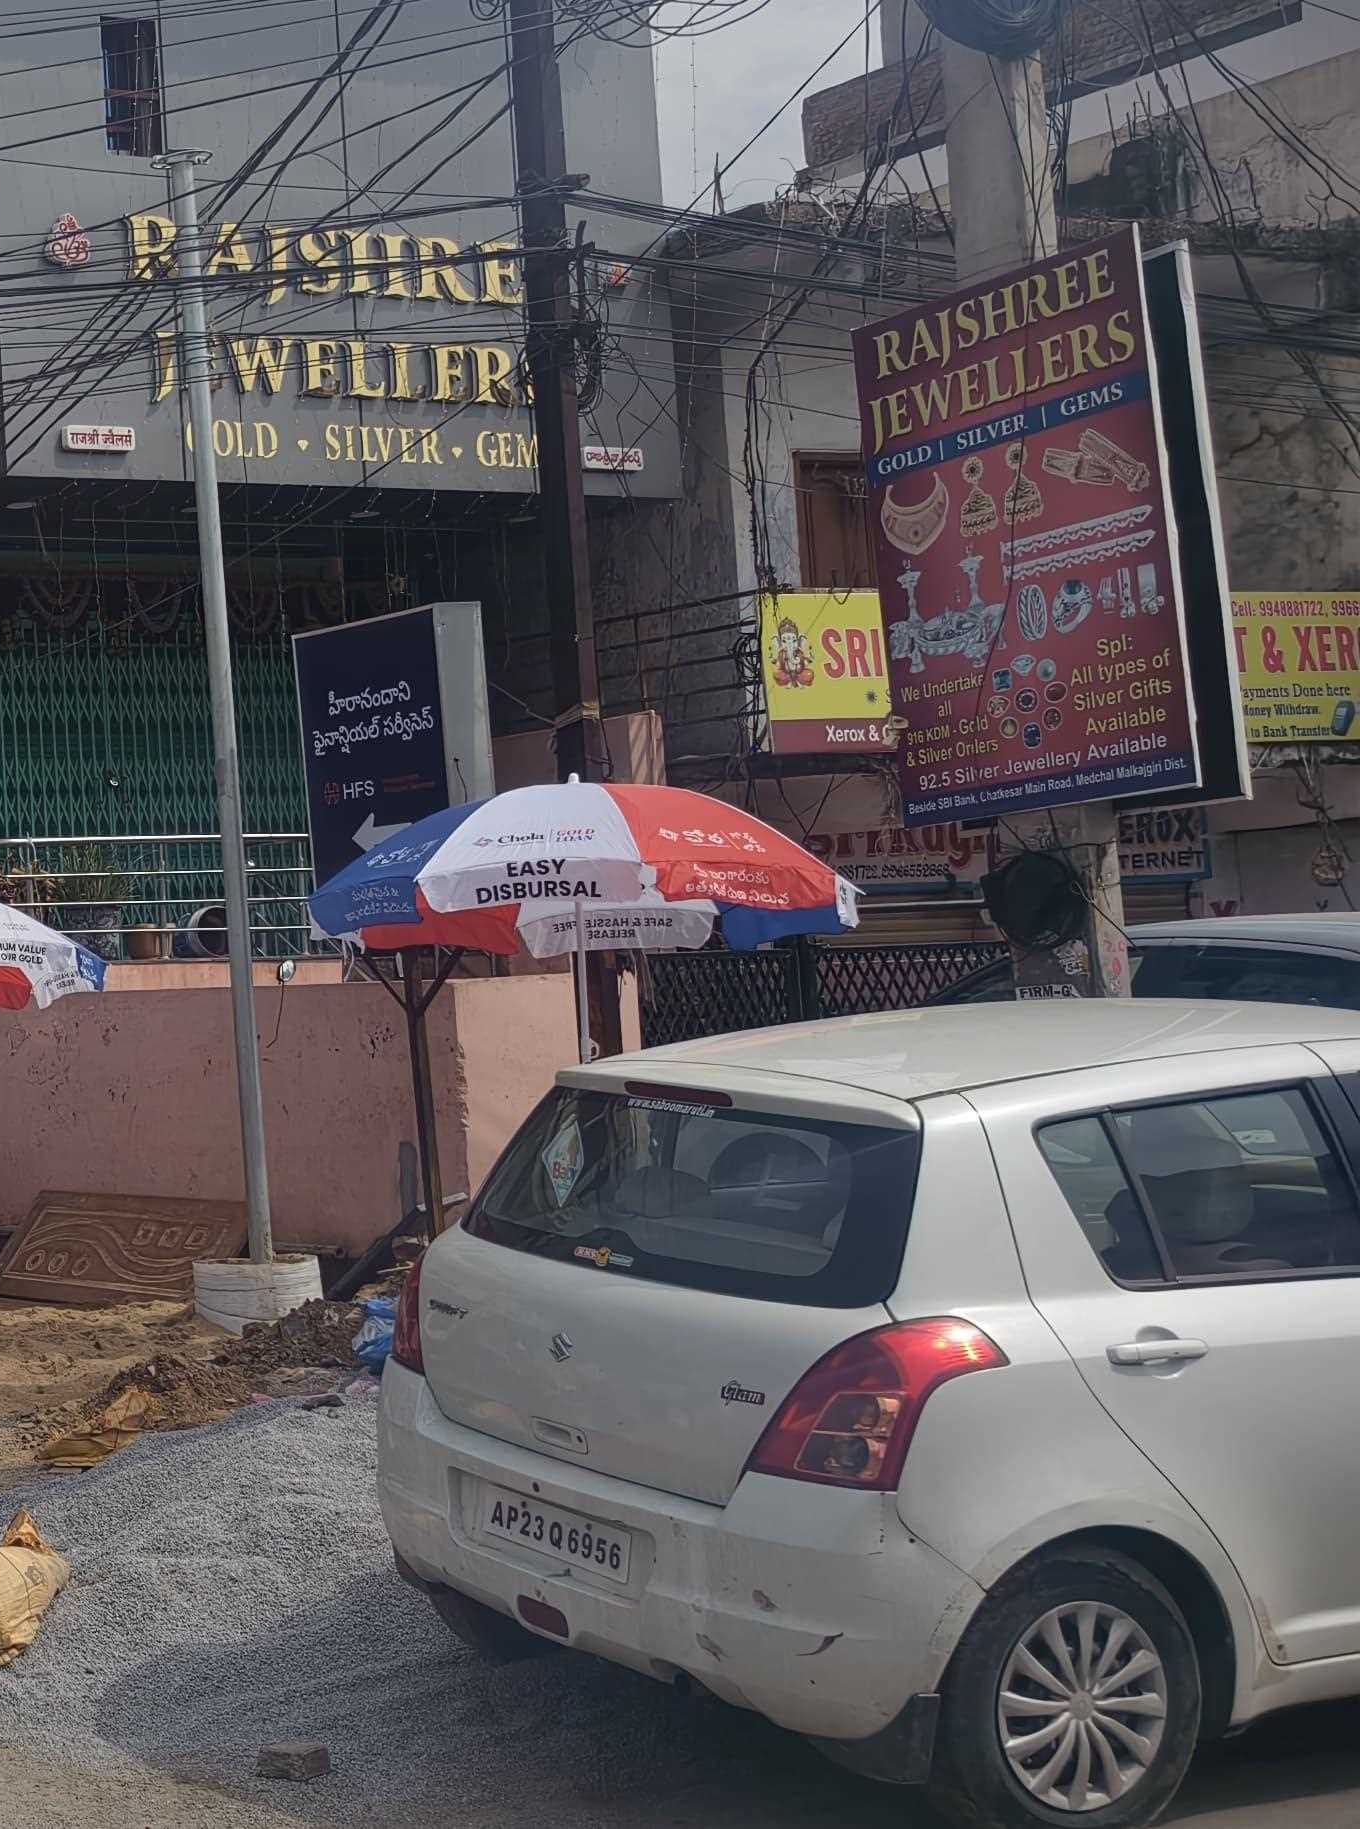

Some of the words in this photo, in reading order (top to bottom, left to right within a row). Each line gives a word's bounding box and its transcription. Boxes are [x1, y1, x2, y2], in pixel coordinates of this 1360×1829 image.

[127, 215, 524, 305] RAJSHRE
[873, 249, 1114, 379] RAJSHREE
[153, 330, 535, 404] JWELLER
[868, 310, 1135, 454] JEWELLERS
[878, 445, 930, 474] GOLD
[956, 415, 1028, 449] SILVER
[1060, 382, 1123, 417] GEMS
[325, 424, 443, 465] SILVER
[476, 430, 538, 468] GEM
[821, 628, 883, 678] SRI
[1096, 634, 1133, 658] Spl:
[1261, 625, 1285, 673] &
[1292, 625, 1360, 672] XER
[1071, 666, 1093, 687] All
[1098, 658, 1146, 684] types
[1152, 648, 1170, 669] of
[901, 687, 920, 703] We
[924, 672, 984, 698] Undertake
[1073, 689, 1123, 711] Silver
[1130, 679, 1172, 700] Gifts
[1240, 684, 1289, 701] ayments
[1292, 683, 1323, 698] Done
[1326, 682, 1351, 697] here
[938, 700, 952, 717] all
[1086, 705, 1167, 735] Available
[826, 724, 865, 742] Xerox
[869, 724, 879, 742] &
[907, 730, 924, 746] 916
[926, 725, 950, 741] KDM
[919, 747, 953, 765] Silver
[919, 772, 951, 791] 92.5
[955, 765, 999, 784] Silver
[1004, 750, 1081, 775] Jewellery
[1087, 733, 1168, 760] Available
[1164, 757, 1188, 770] Dist.
[343, 780, 375, 799] HFS
[497, 832, 544, 844] Chola
[1119, 808, 1195, 844] EROX
[507, 859, 566, 877] EASY
[1119, 850, 1204, 870] TERNET
[476, 880, 602, 905] DISBURSAL
[18, 943, 47, 956] VALUE
[19, 954, 43, 965] GOLD
[491, 1501, 545, 1541] AP23
[549, 1521, 563, 1550] Q
[567, 1527, 621, 1570] 6956
